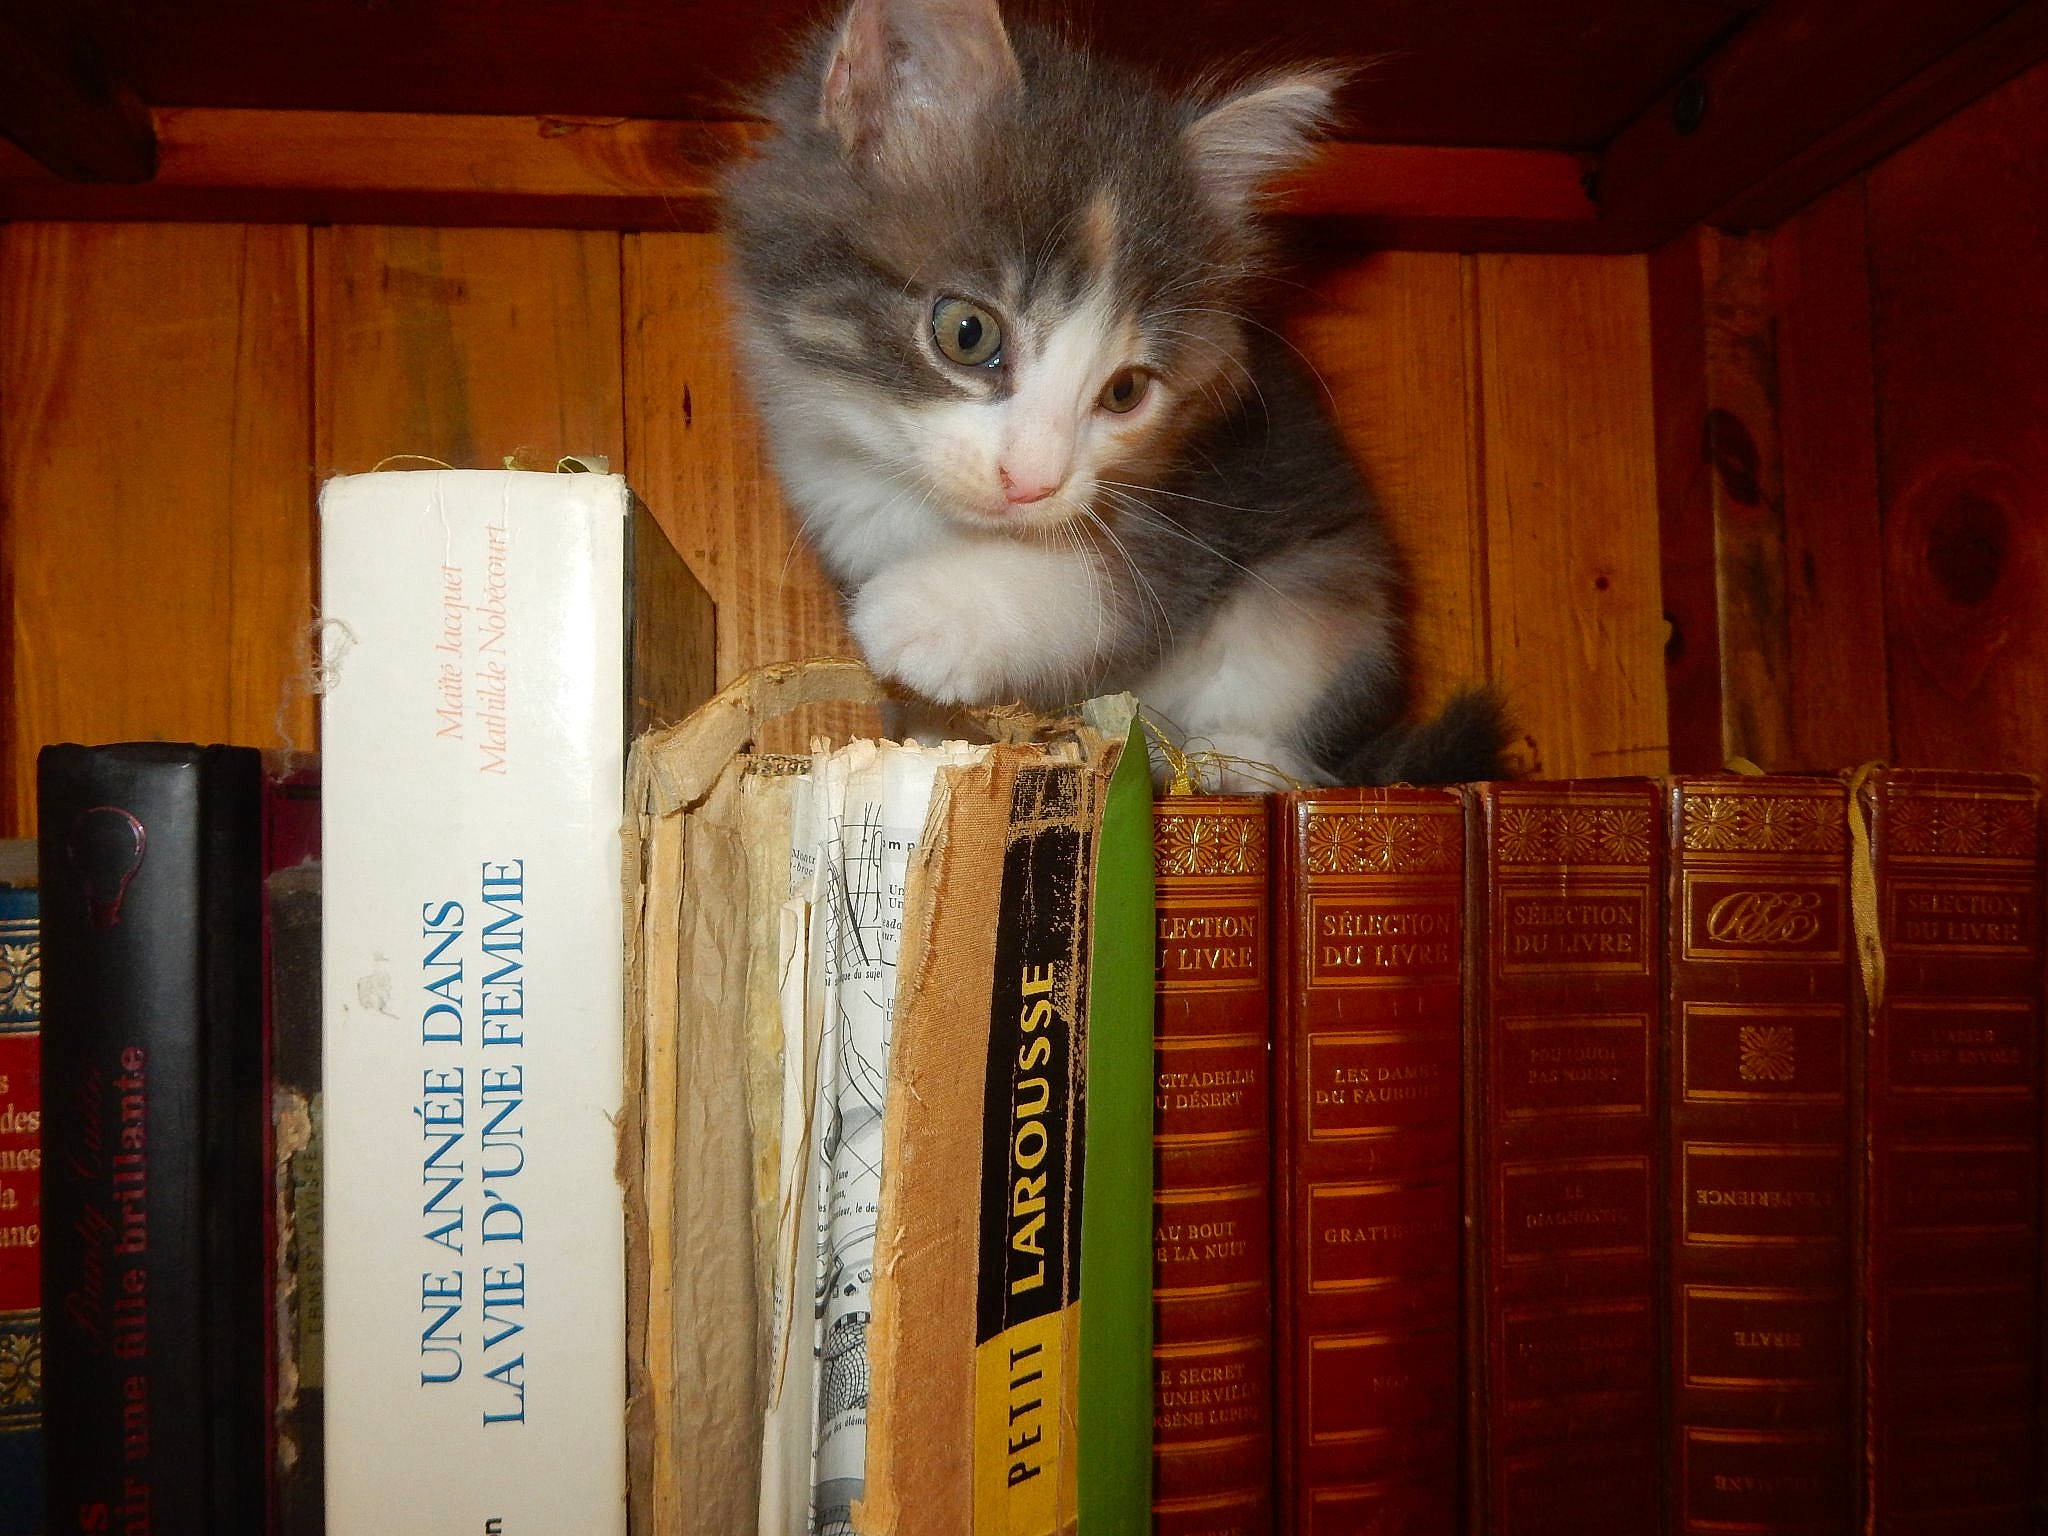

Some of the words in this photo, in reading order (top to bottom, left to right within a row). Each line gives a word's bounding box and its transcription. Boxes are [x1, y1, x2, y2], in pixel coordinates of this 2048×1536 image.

[436, 561, 470, 658] Jacquet
[476, 523, 508, 656] Nobécourt
[476, 660, 508, 776] Mathilde
[481, 858, 524, 1048] FEMME
[1157, 916, 1256, 940] LECTION
[1178, 947, 1254, 970] LIVRE
[1322, 910, 1451, 936] SÉLECTION
[1322, 945, 1364, 968] DU
[1374, 943, 1449, 967] LIVRE
[1513, 901, 1635, 927] SÉLECTION
[1559, 932, 1634, 953] LIVRE
[422, 900, 465, 1047] DANS
[1335, 1068, 1369, 1084] LES
[111, 1046, 148, 1256] brillante
[413, 1066, 465, 1257] ANNÉE
[481, 1064, 525, 1245] D'UNE
[1011, 962, 1055, 1296] LAROUSSE
[1175, 1246, 1199, 1261] LA
[1188, 1221, 1235, 1240] BOUT
[113, 1268, 148, 1359] fille
[420, 1270, 463, 1388] UNE
[481, 1262, 525, 1352] VIE
[122, 1376, 150, 1462] une
[481, 1352, 525, 1428] LA
[1008, 1343, 1043, 1489] PETIT
